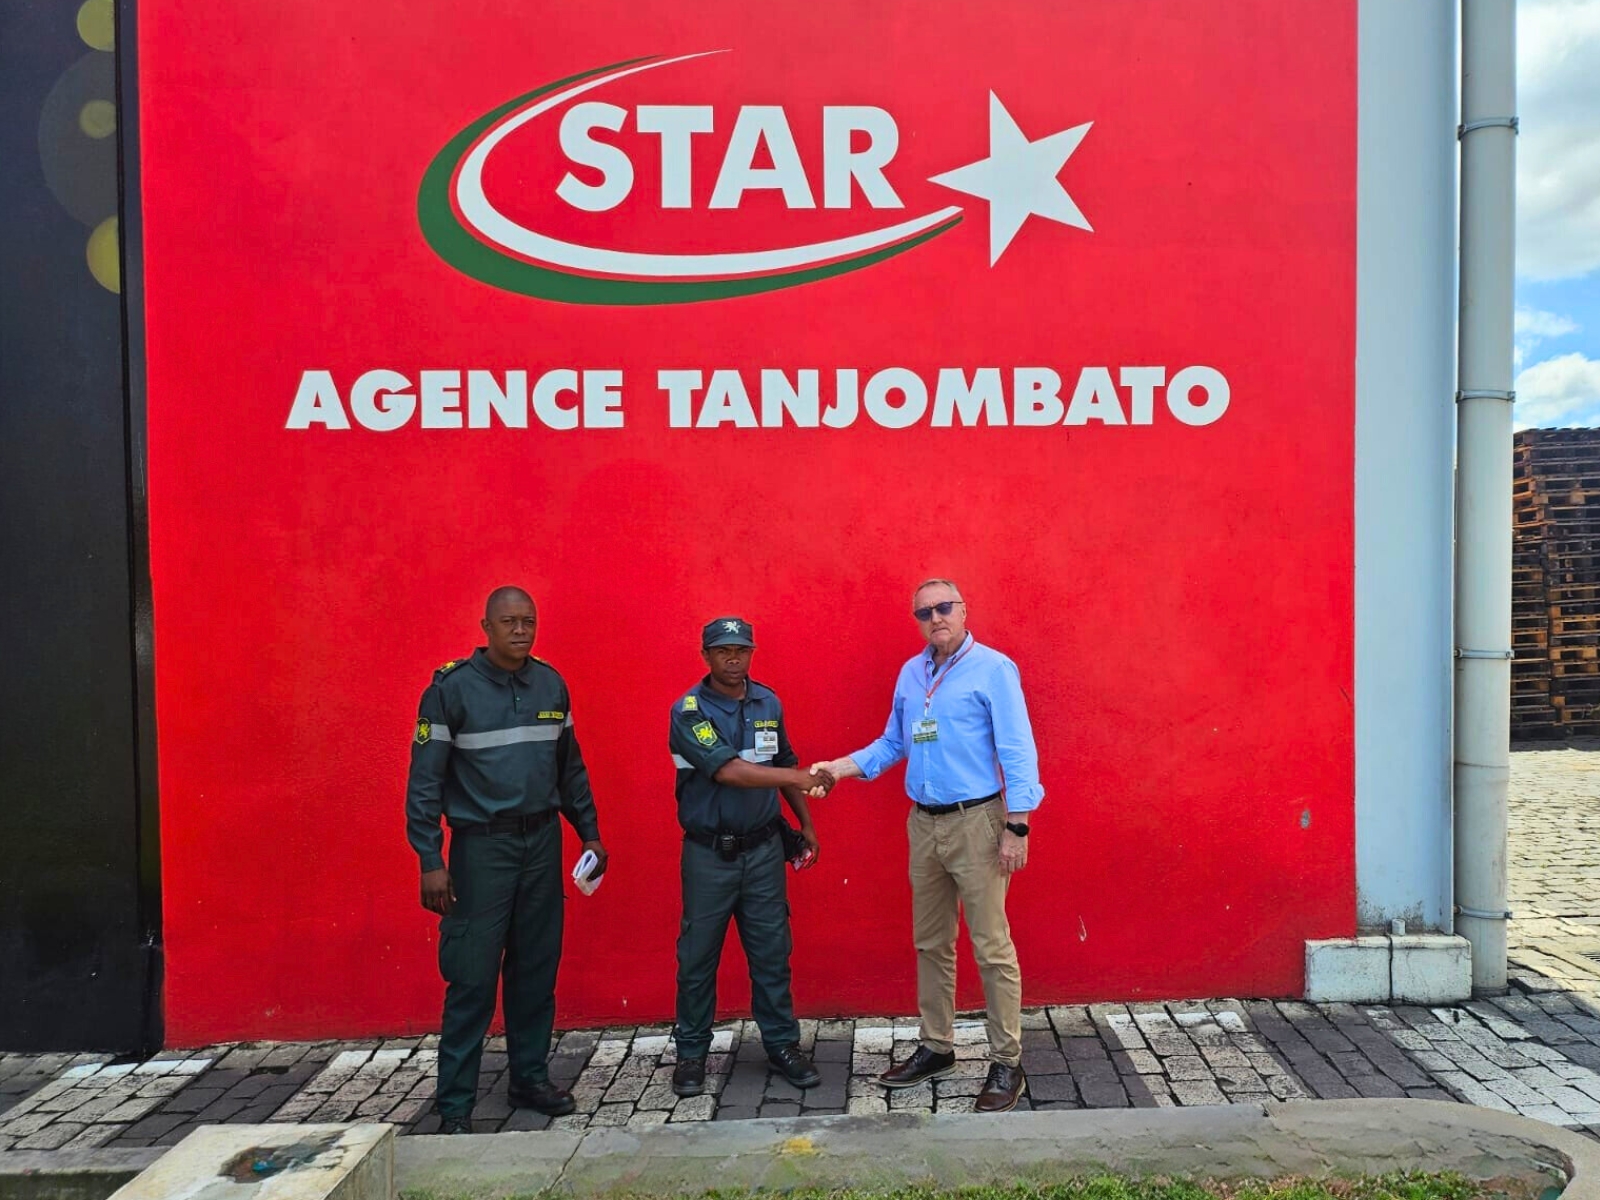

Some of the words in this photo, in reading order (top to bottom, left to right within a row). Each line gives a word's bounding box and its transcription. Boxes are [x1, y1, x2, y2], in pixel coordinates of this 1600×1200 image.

[555, 101, 905, 212] STAR
[285, 368, 625, 431] AGENCE
[657, 365, 1231, 429] TANJOMBATO
